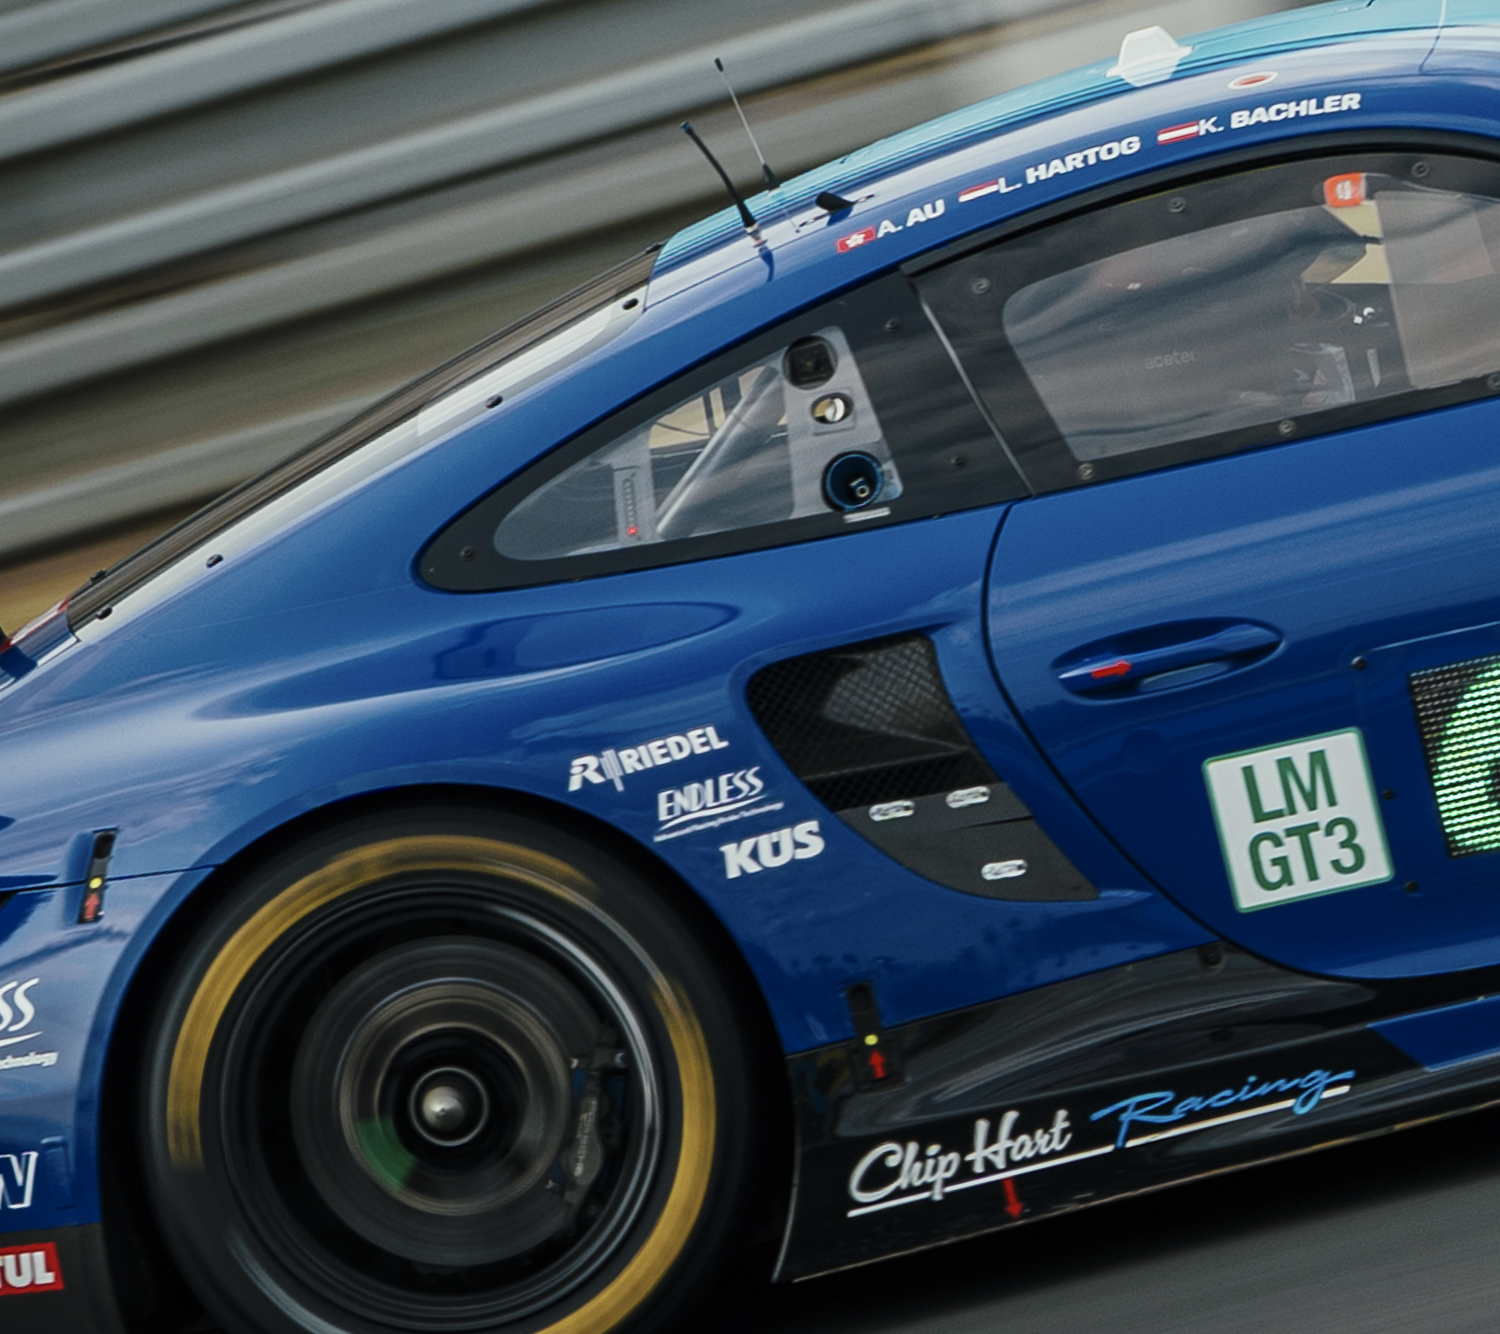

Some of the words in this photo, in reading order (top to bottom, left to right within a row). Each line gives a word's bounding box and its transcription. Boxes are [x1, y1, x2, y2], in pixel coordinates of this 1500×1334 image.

[1199, 116, 1224, 135] K.
[1230, 92, 1361, 129] BACHLER
[999, 175, 1022, 193] L.
[1027, 136, 1141, 185] HARTOG
[876, 218, 902, 238] A.
[906, 200, 946, 228] AU
[658, 766, 764, 822] ENDLESS
[1242, 749, 1338, 823] LM
[1248, 816, 1366, 892] GT3
[849, 1141, 959, 1200] Chip
[965, 1109, 1075, 1173] Hart
[1090, 1069, 1355, 1149] Racing
